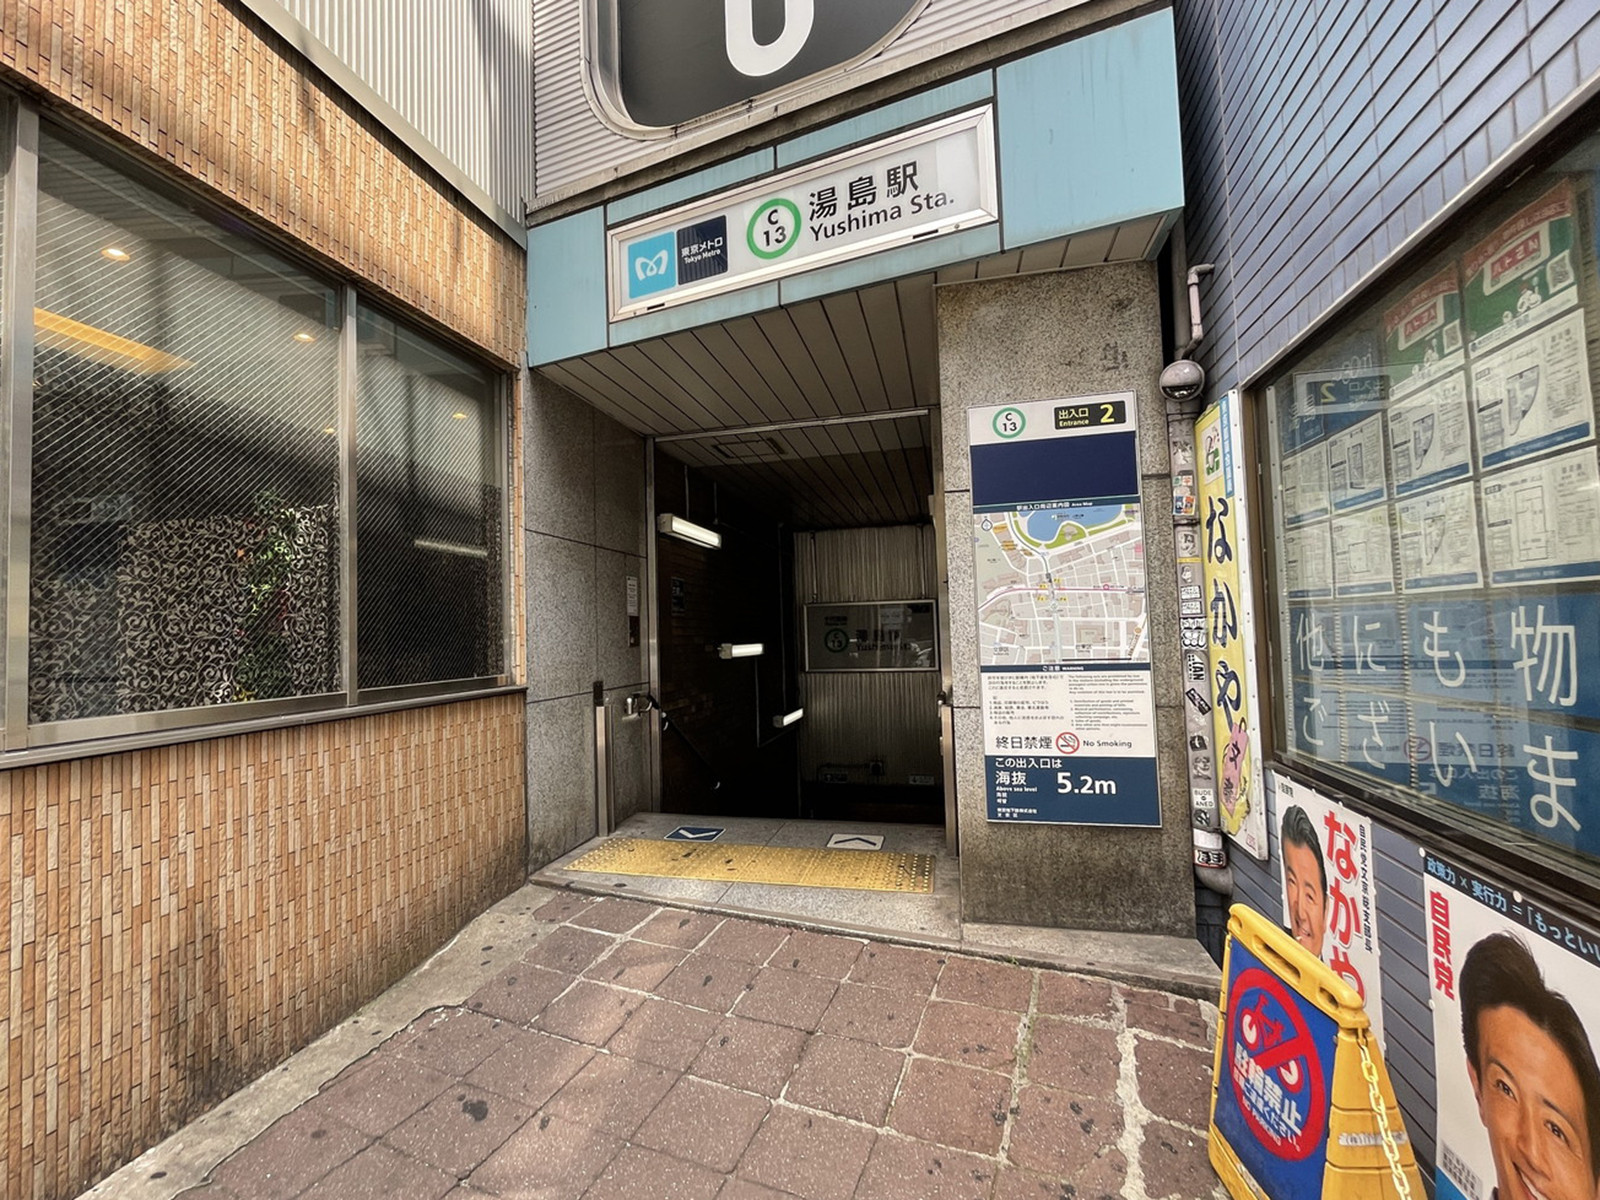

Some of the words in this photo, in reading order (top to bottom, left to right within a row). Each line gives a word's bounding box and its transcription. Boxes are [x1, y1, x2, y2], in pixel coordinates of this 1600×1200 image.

[809, 161, 919, 221] 湯島駅
[767, 209, 779, 226] C
[810, 204, 901, 241] Yushima
[911, 192, 954, 214] Sta.
[763, 226, 787, 246] 13
[681, 237, 723, 257] 東京メトロ
[684, 253, 702, 264] Tokyo
[702, 249, 721, 258] Metro
[1005, 413, 1013, 421] C
[1058, 408, 1089, 419] 出入口
[1100, 404, 1115, 423] 2
[1002, 422, 1017, 432] 13
[1059, 418, 1090, 427] Entrance
[995, 736, 1053, 749] 終日禁煙
[1097, 740, 1133, 748] Smoking
[995, 758, 1063, 769] この出入口は
[995, 771, 1026, 785] 海抜
[1057, 772, 1116, 794] 5.2m
[1427, 856, 1456, 884] 政策力
[1471, 880, 1507, 912] 実行力
